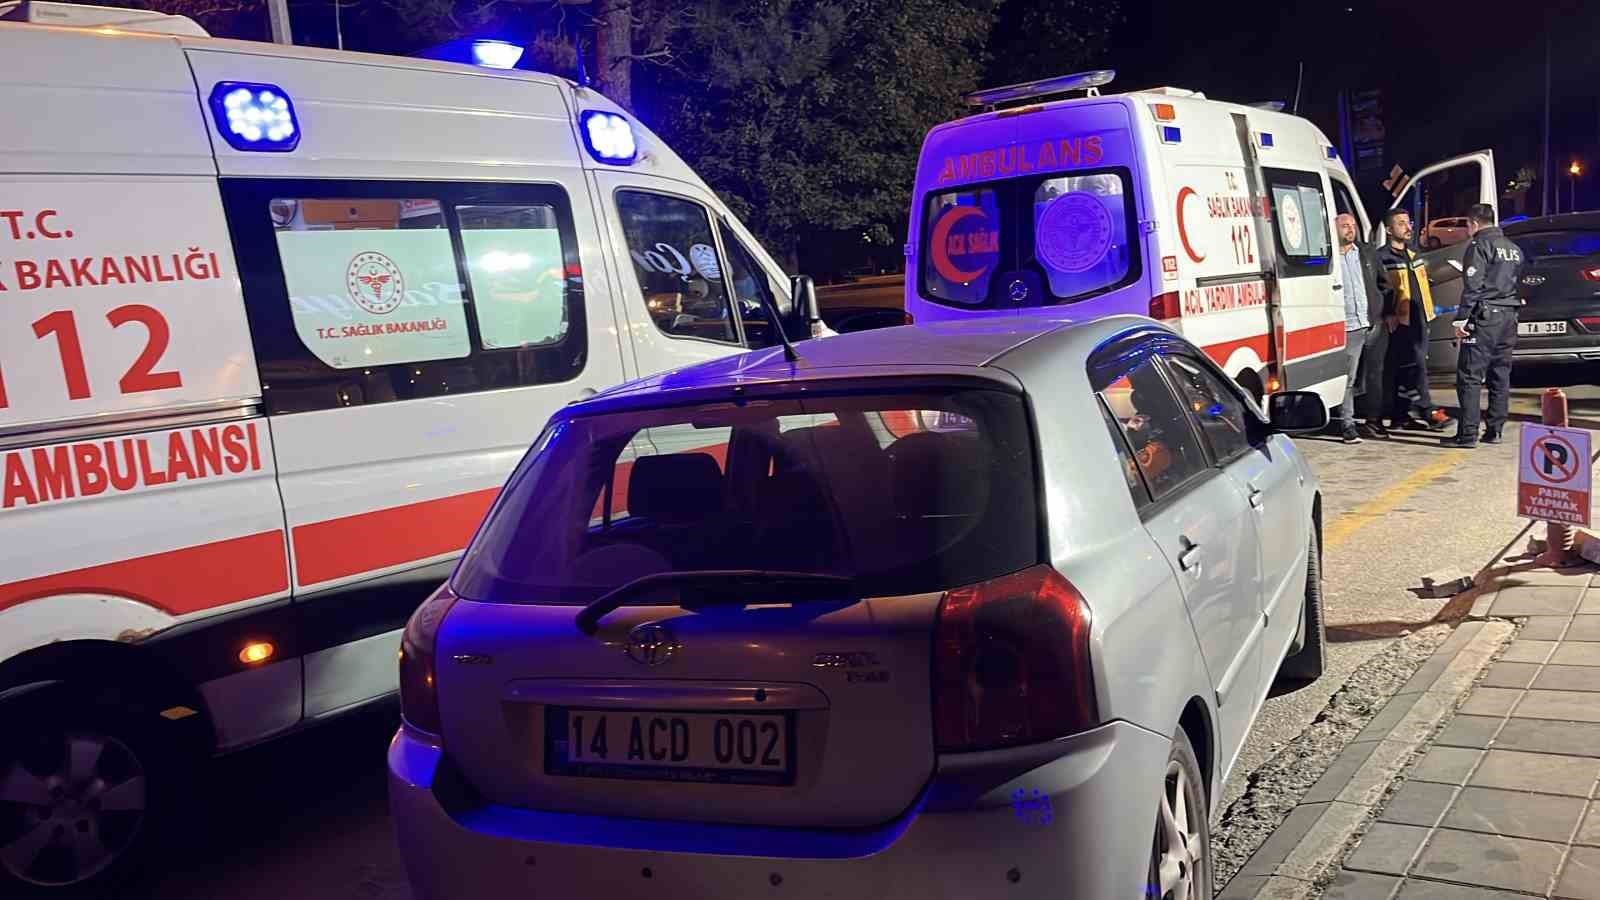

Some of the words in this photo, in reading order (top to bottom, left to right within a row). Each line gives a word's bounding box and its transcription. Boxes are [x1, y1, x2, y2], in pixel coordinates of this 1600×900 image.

[938, 136, 1104, 184] AMBULANS
[0, 209, 74, 240] T.C.
[1231, 224, 1254, 265] 112
[14, 247, 220, 290] BAKANLIĞI
[342, 322, 384, 338] SAĞLIK
[386, 317, 448, 335] BAKANLIĞI
[0, 303, 183, 409] 12
[2, 422, 262, 508] AMBULANSI
[1524, 505, 1584, 522] YASAKTIR
[1529, 496, 1578, 512] YAPMAK
[1538, 487, 1569, 500] PARK
[573, 715, 608, 759] 14
[627, 716, 689, 762] ACD
[714, 719, 781, 766] 002
